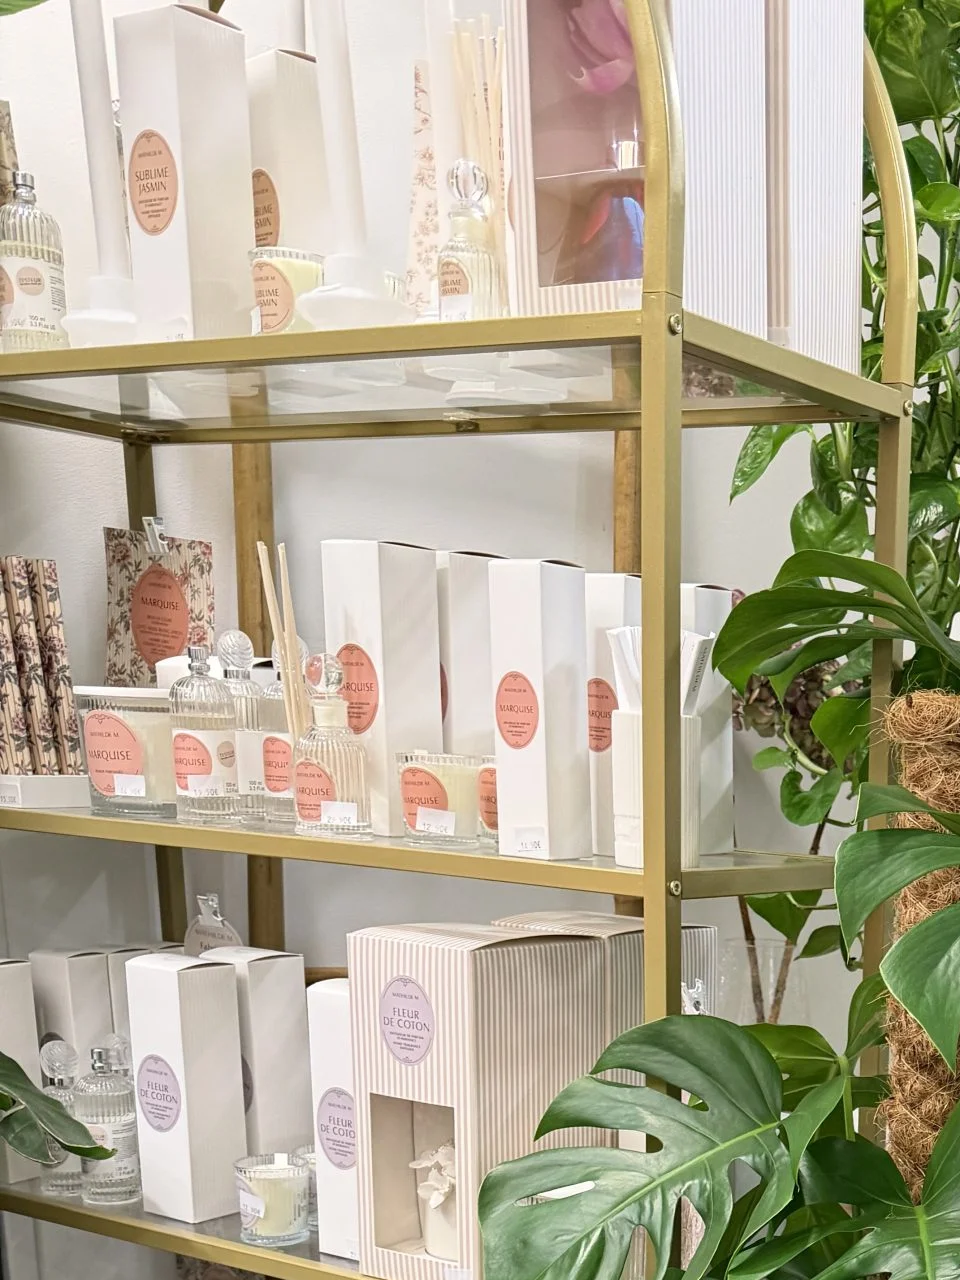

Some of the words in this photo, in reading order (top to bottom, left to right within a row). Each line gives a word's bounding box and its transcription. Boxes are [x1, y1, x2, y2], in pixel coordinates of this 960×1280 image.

[135, 167, 169, 182] SUBLIME
[138, 181, 167, 196] JASMIN
[259, 299, 278, 307] SMIN
[141, 596, 180, 611] MARQUISE
[342, 682, 375, 693] ARQUISE
[499, 704, 535, 715] MARQUISE
[88, 750, 132, 761] MARQUISE
[175, 758, 207, 767] ARQUISE
[297, 787, 331, 796] ARQUISE
[392, 1007, 420, 1019] FLEUR
[383, 1016, 394, 1026] DE
[397, 1018, 430, 1032] COTON
[147, 1081, 169, 1093] FLEUR
[140, 1089, 149, 1098] DE
[150, 1091, 178, 1104] COTON
[328, 1115, 353, 1128] FLEUR
[320, 1123, 330, 1134] DE
[332, 1126, 356, 1138] COTO
